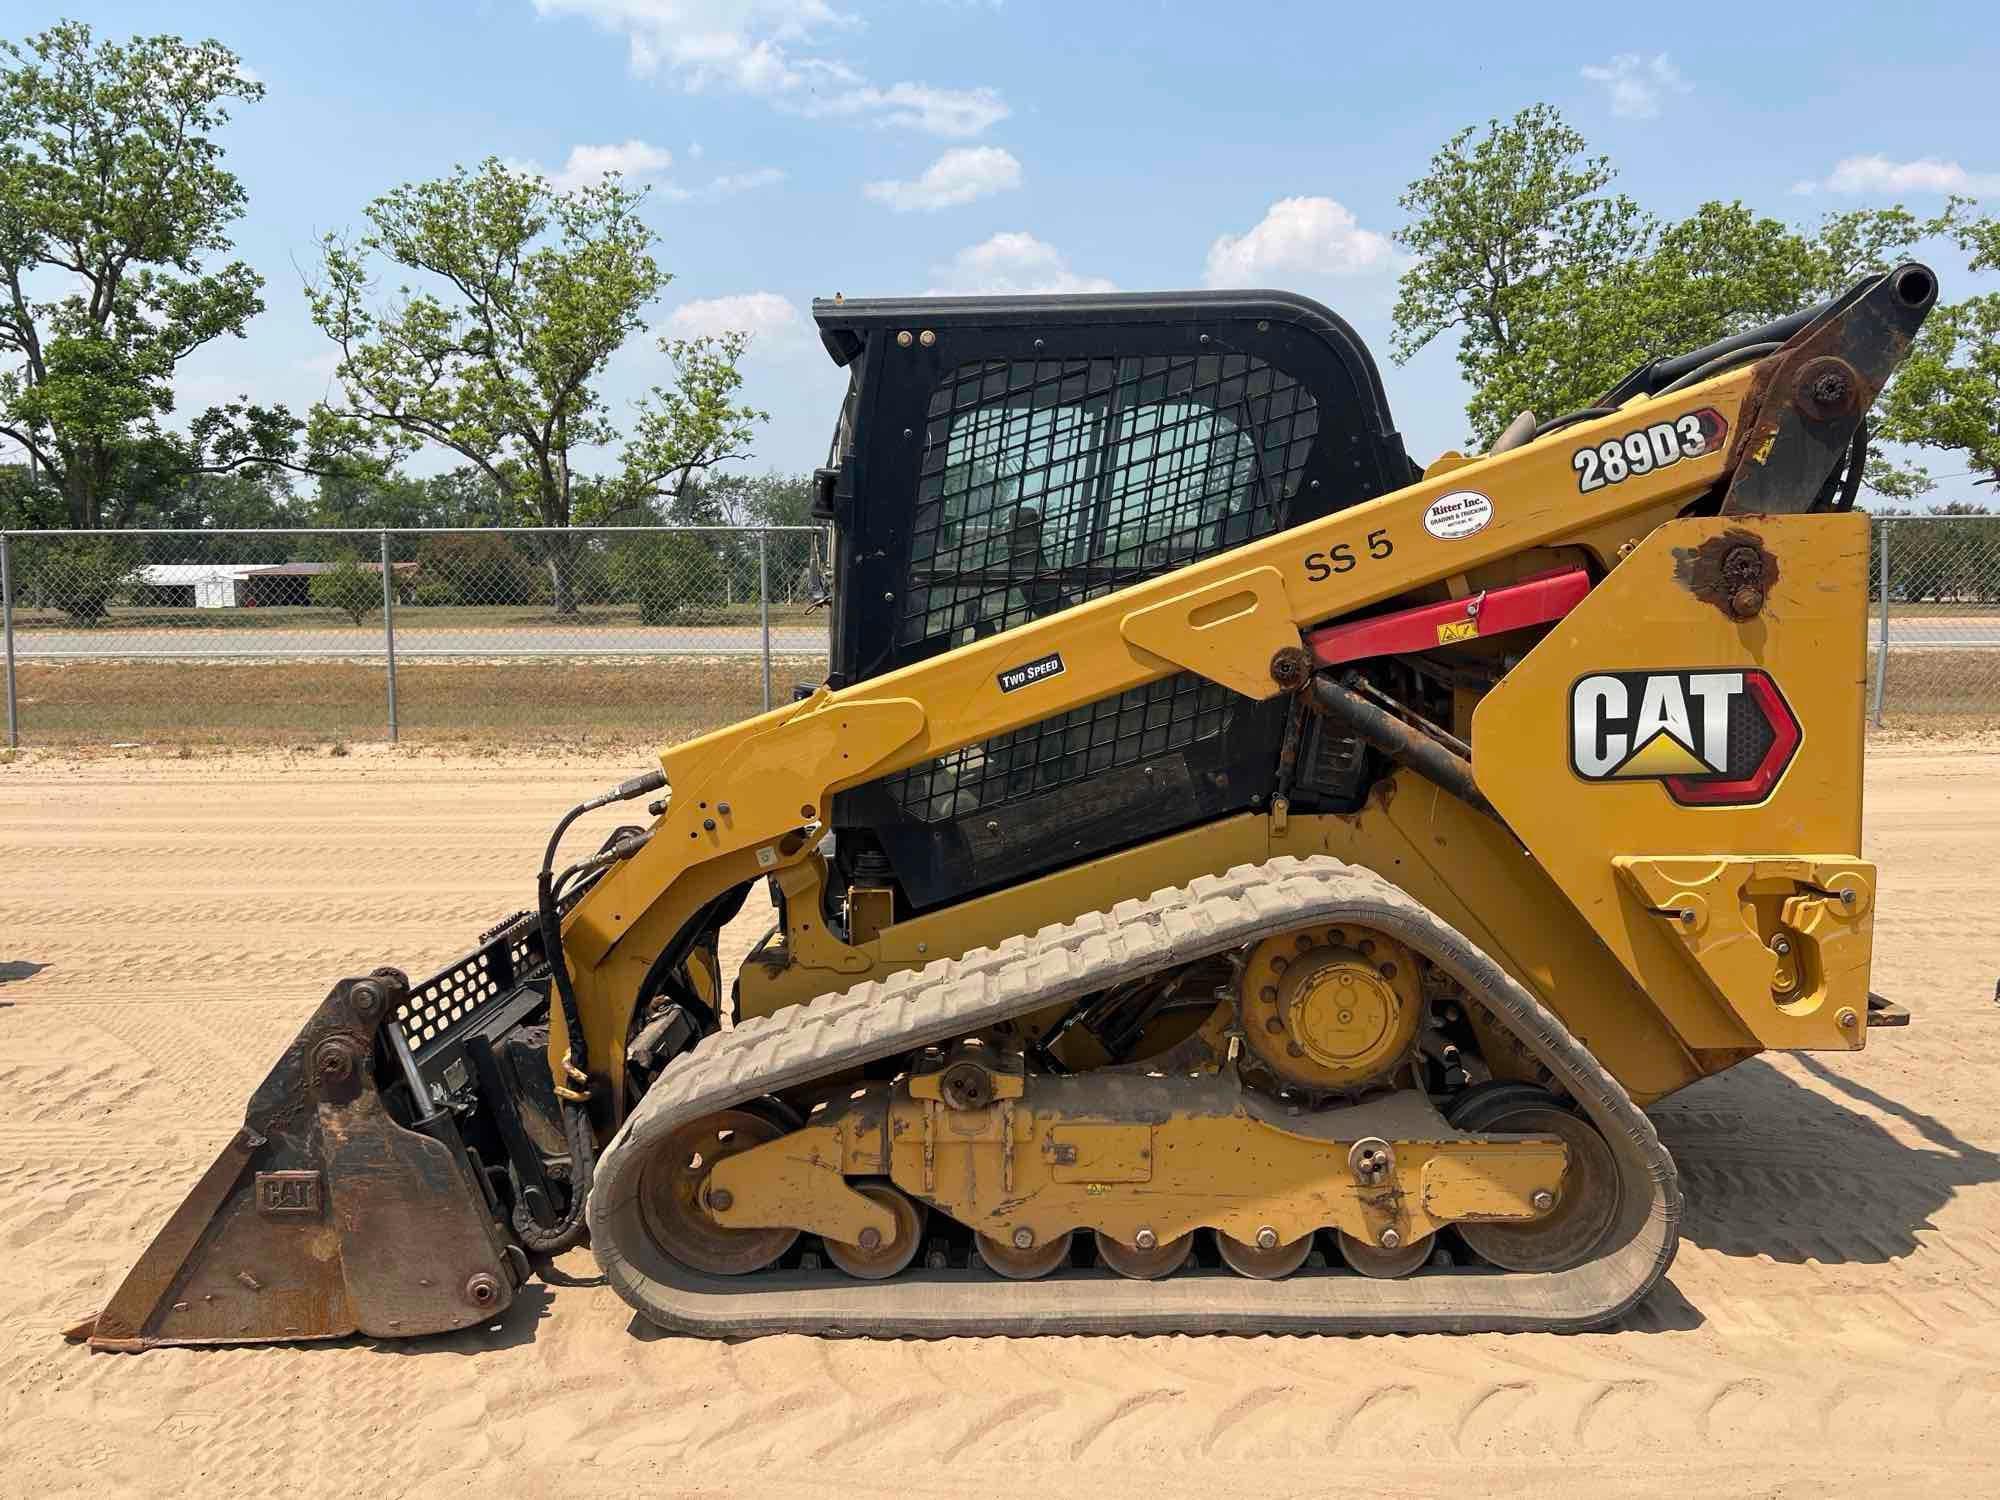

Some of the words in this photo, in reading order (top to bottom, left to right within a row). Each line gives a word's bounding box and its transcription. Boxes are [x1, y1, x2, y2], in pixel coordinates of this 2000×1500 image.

[1574, 415, 1706, 492] 289D3
[1432, 503, 1462, 516] Ritter
[1463, 498, 1484, 508] Inc.
[1305, 543, 1356, 582] SS
[1368, 529, 1393, 559] 5
[1574, 673, 1743, 776] CAT
[264, 1182, 312, 1209] CAT
